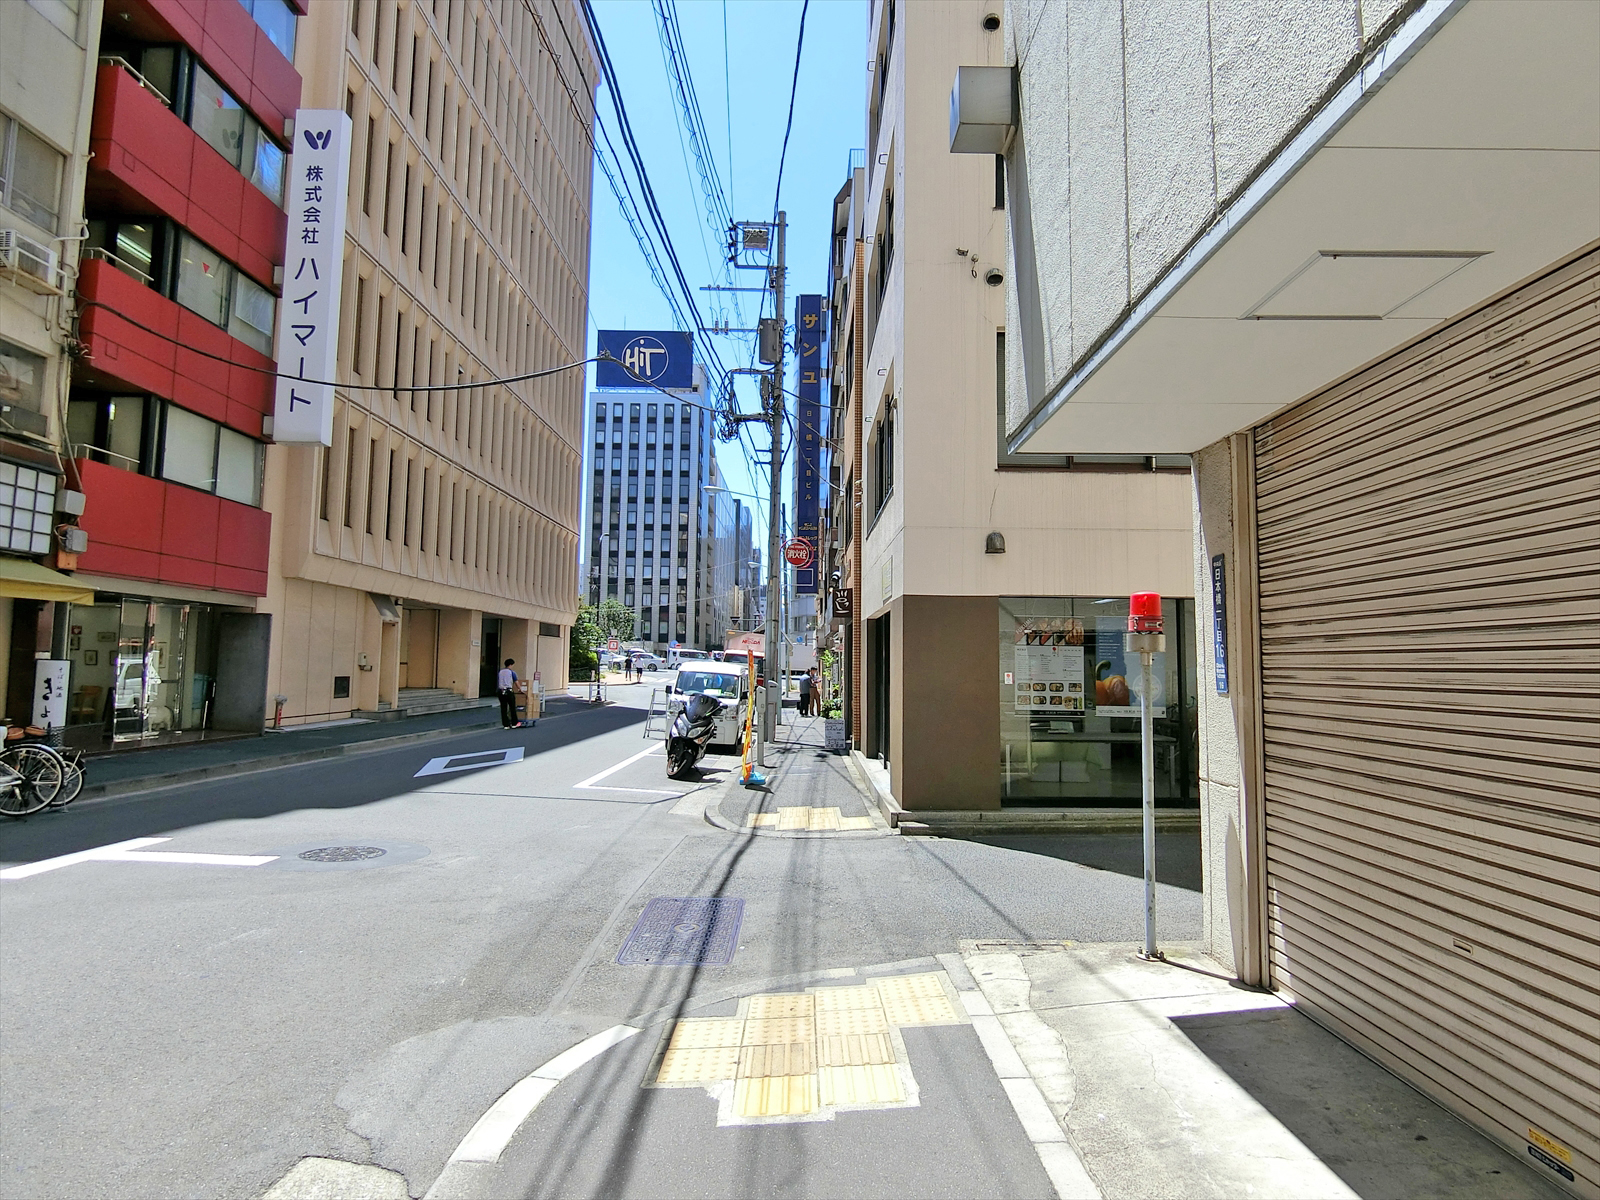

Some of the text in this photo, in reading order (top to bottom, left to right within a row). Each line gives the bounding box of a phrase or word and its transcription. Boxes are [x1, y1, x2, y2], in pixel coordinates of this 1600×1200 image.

[290, 165, 323, 412] 株式会社ハイマート
[802, 313, 818, 384] サンユ
[788, 549, 807, 559] 消火栓
